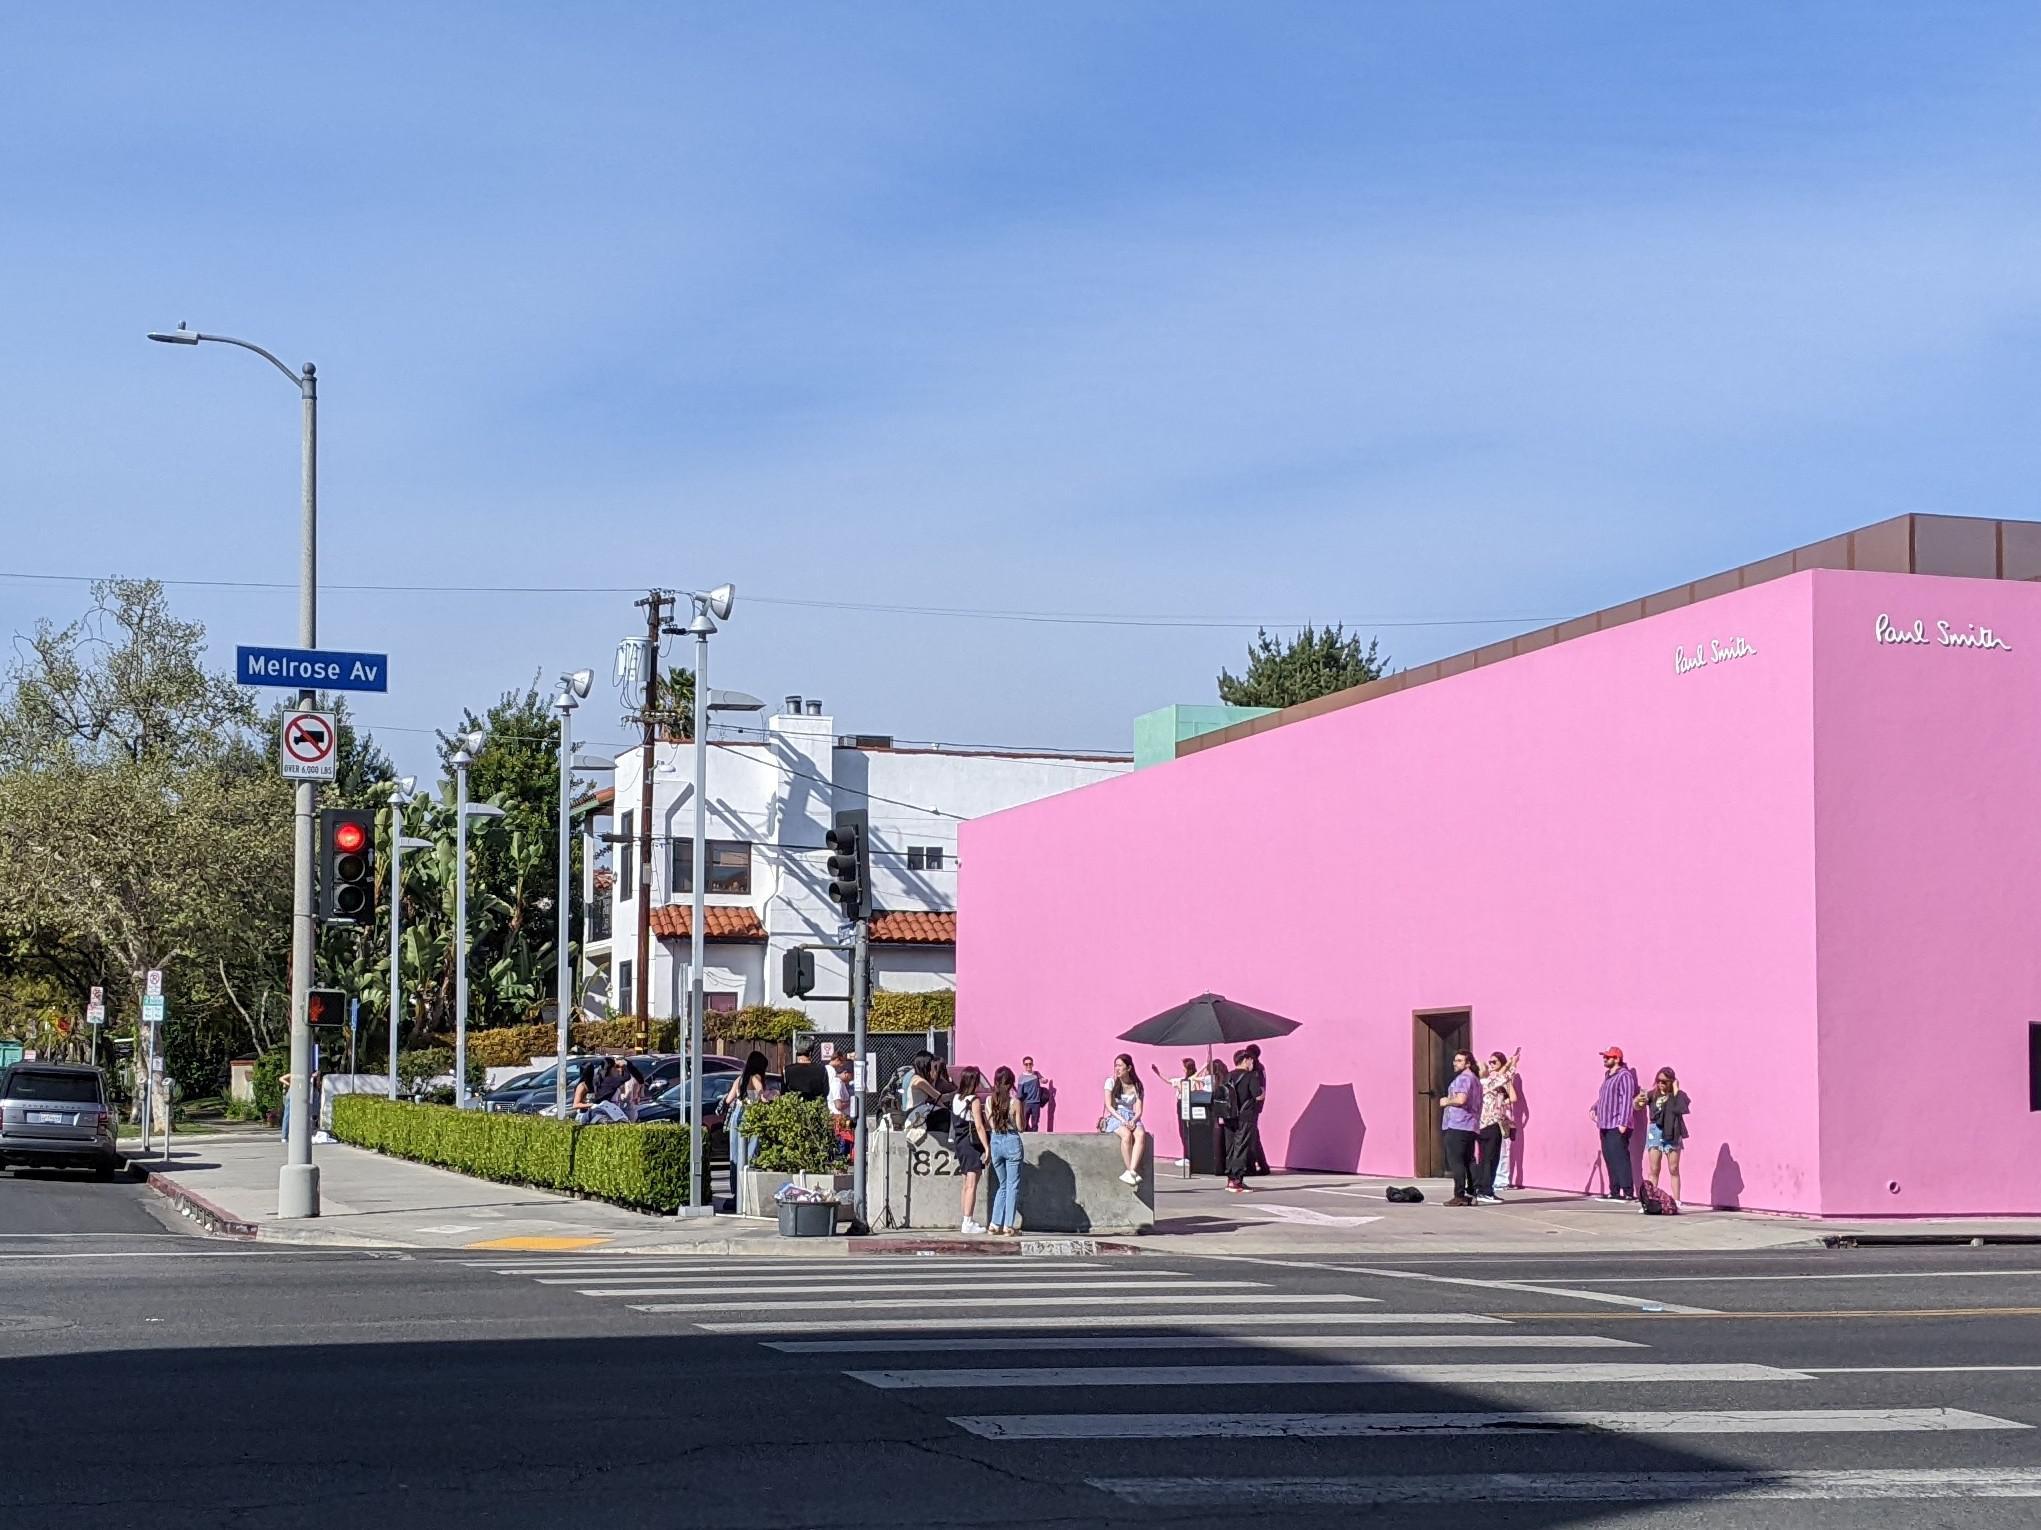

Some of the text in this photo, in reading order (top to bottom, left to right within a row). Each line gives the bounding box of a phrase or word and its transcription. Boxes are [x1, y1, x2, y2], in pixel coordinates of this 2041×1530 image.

[1875, 613, 2012, 651] Paul Smith
[248, 654, 378, 681] Melrose Av
[1675, 636, 1757, 674] Paul Smith
[284, 764, 300, 773] OVER
